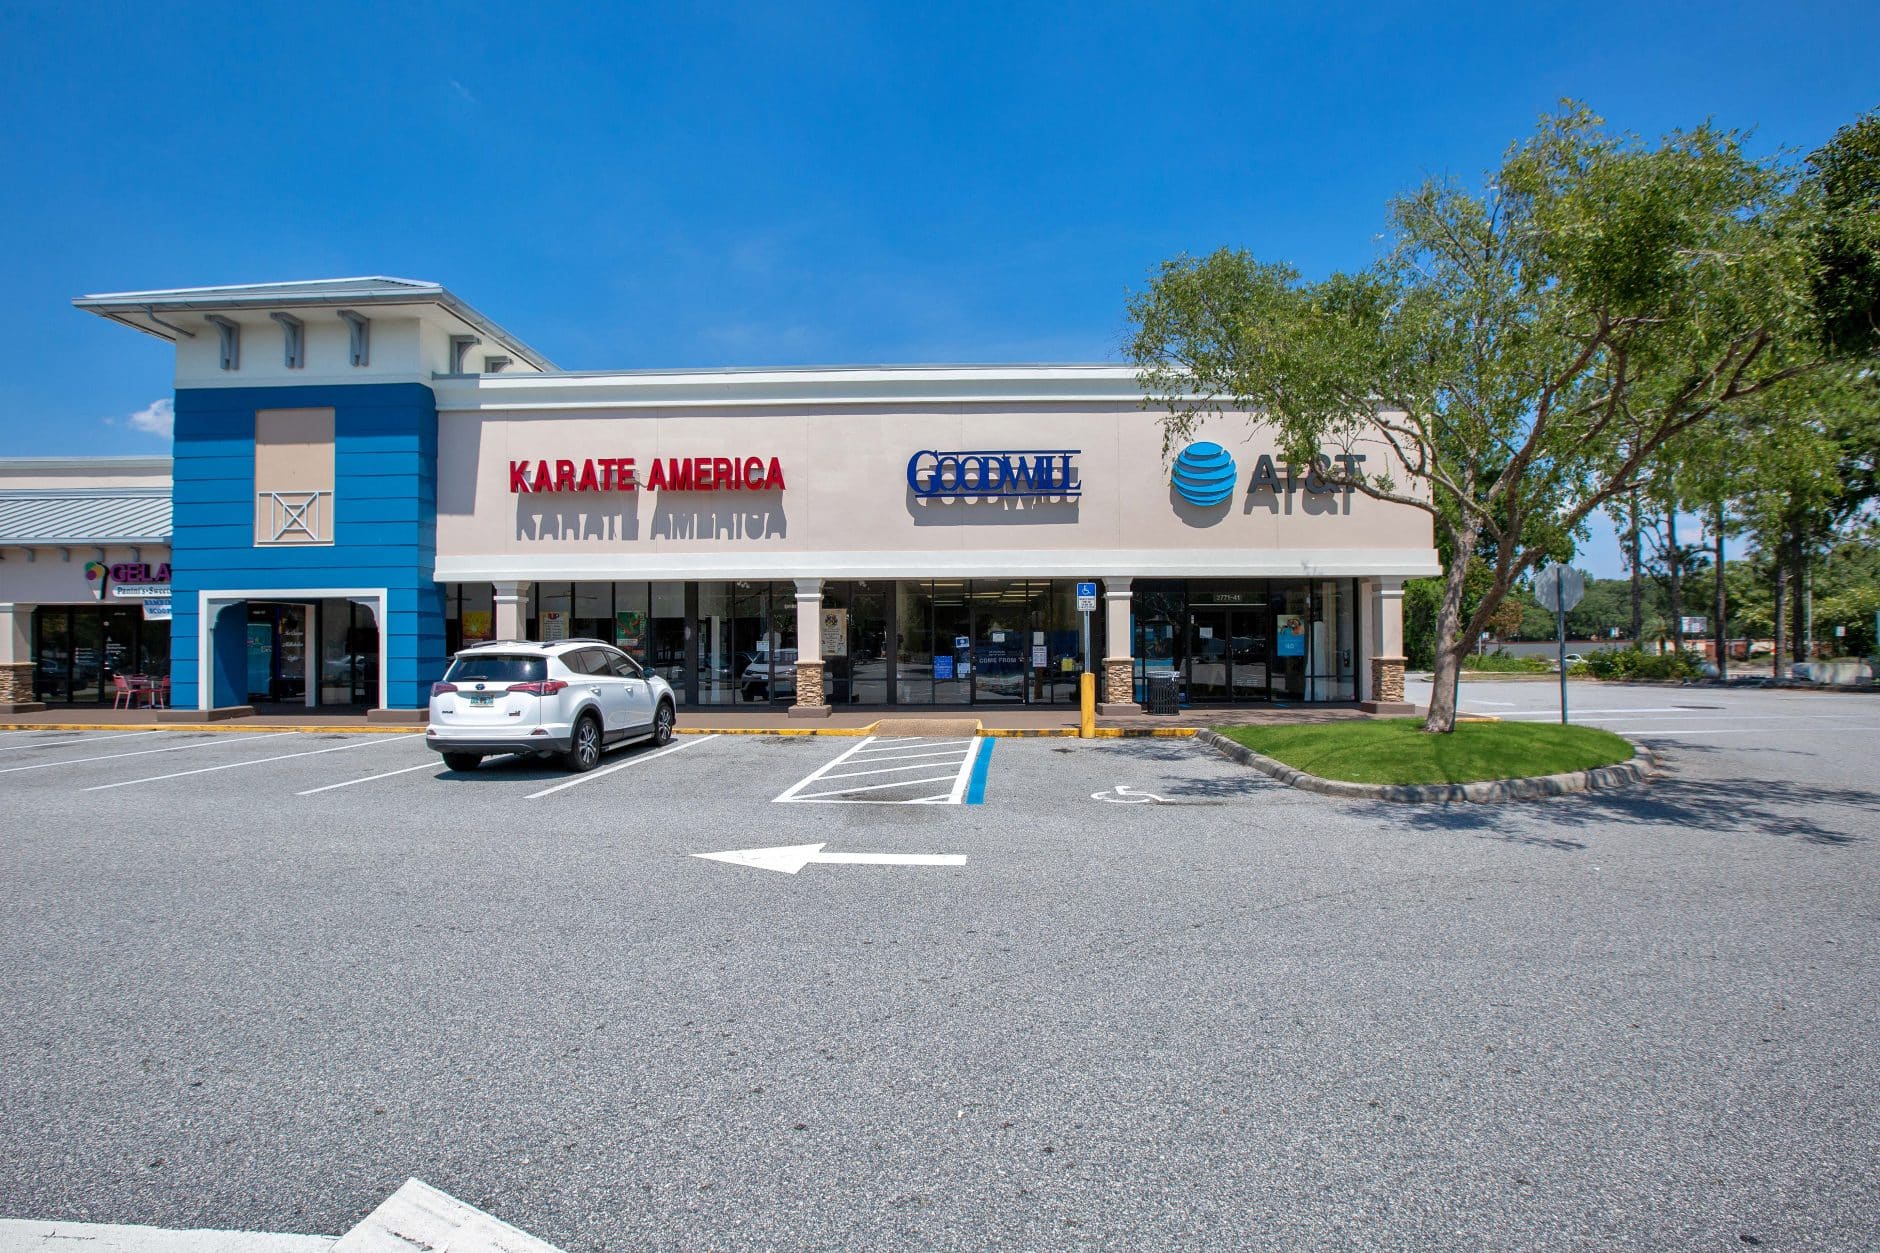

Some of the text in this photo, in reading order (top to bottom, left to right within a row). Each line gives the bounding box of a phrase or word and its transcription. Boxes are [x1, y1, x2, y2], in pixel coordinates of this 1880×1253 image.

[509, 456, 786, 493] KARATE AMERICA
[907, 450, 1082, 496] GOODWILL
[1247, 454, 1366, 494] AT&T
